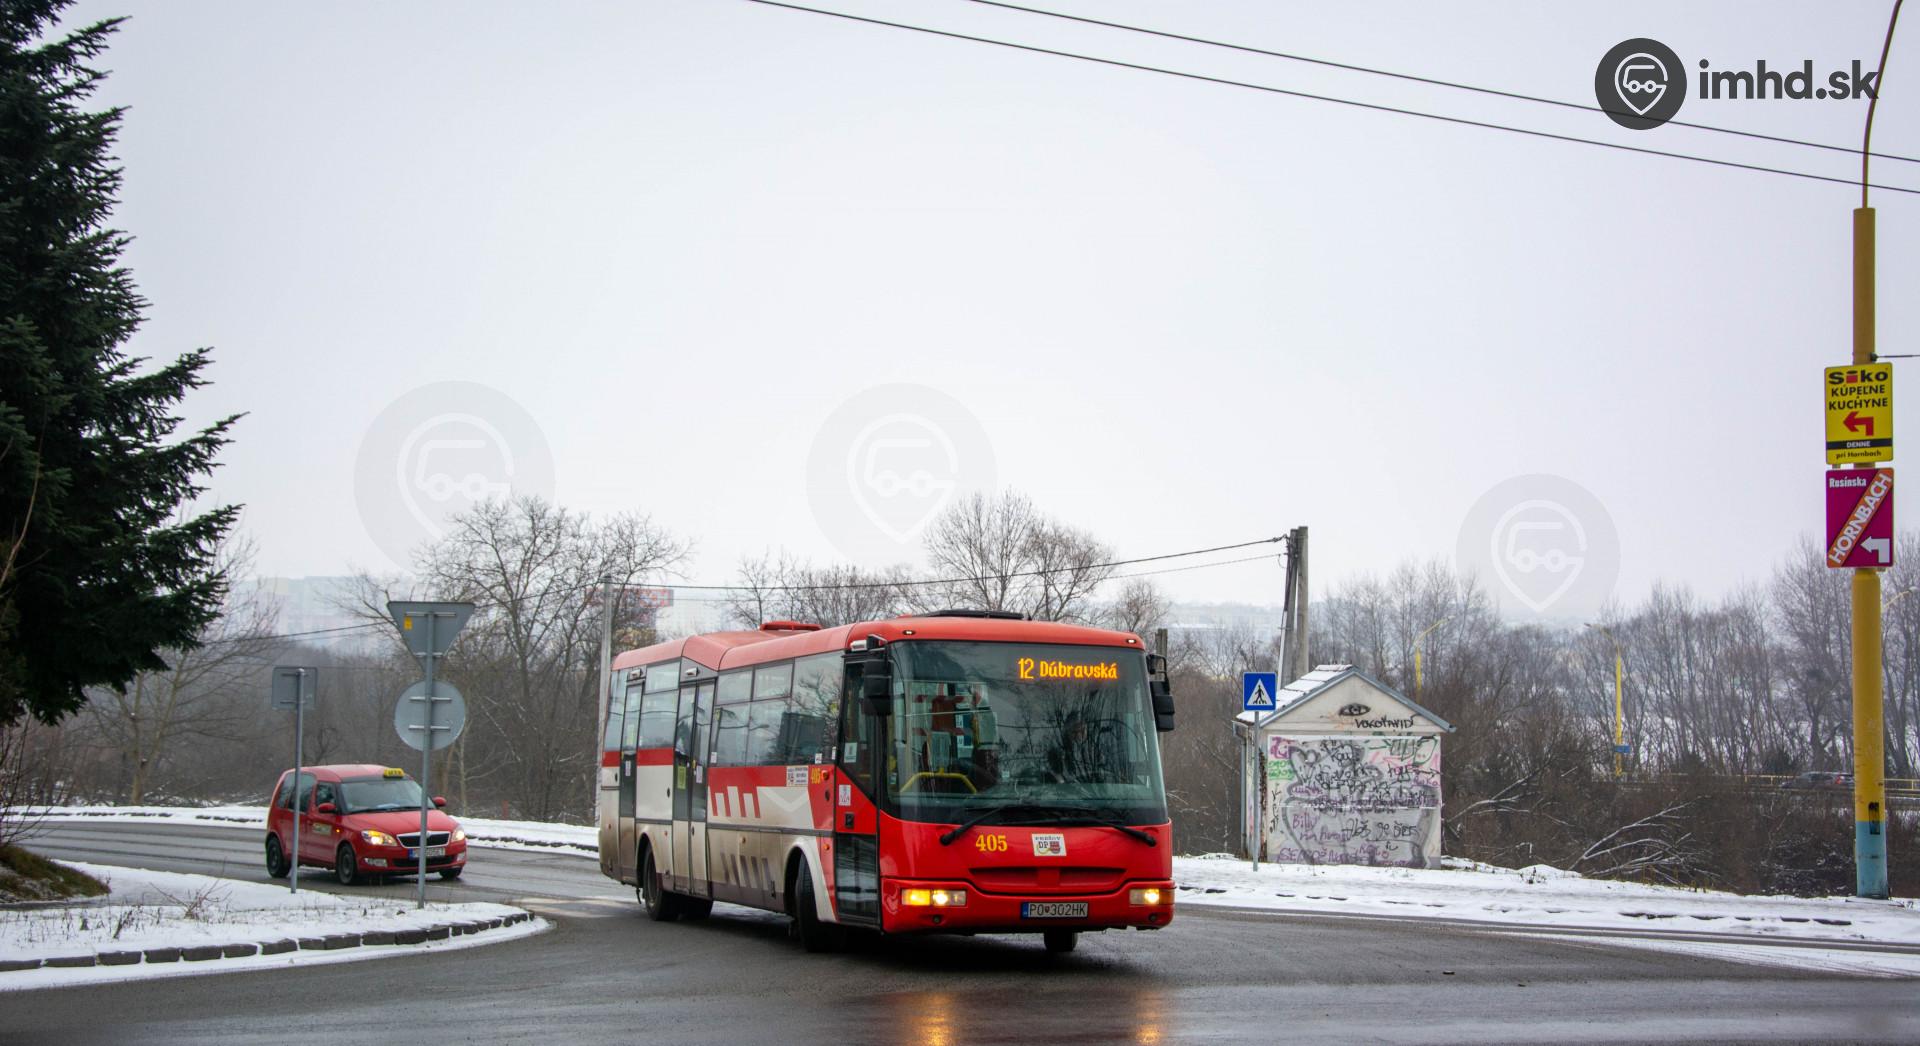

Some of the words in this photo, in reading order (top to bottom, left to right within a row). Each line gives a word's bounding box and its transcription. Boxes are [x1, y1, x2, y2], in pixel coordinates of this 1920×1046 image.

[1828, 397, 1888, 411] KUCHYNE
[1847, 449, 1882, 458] Hornbach
[1828, 473, 1892, 563] HORNBACH
[1017, 657, 1035, 680] 12
[1039, 660, 1118, 680] Dúbravská
[975, 834, 1008, 852] 405
